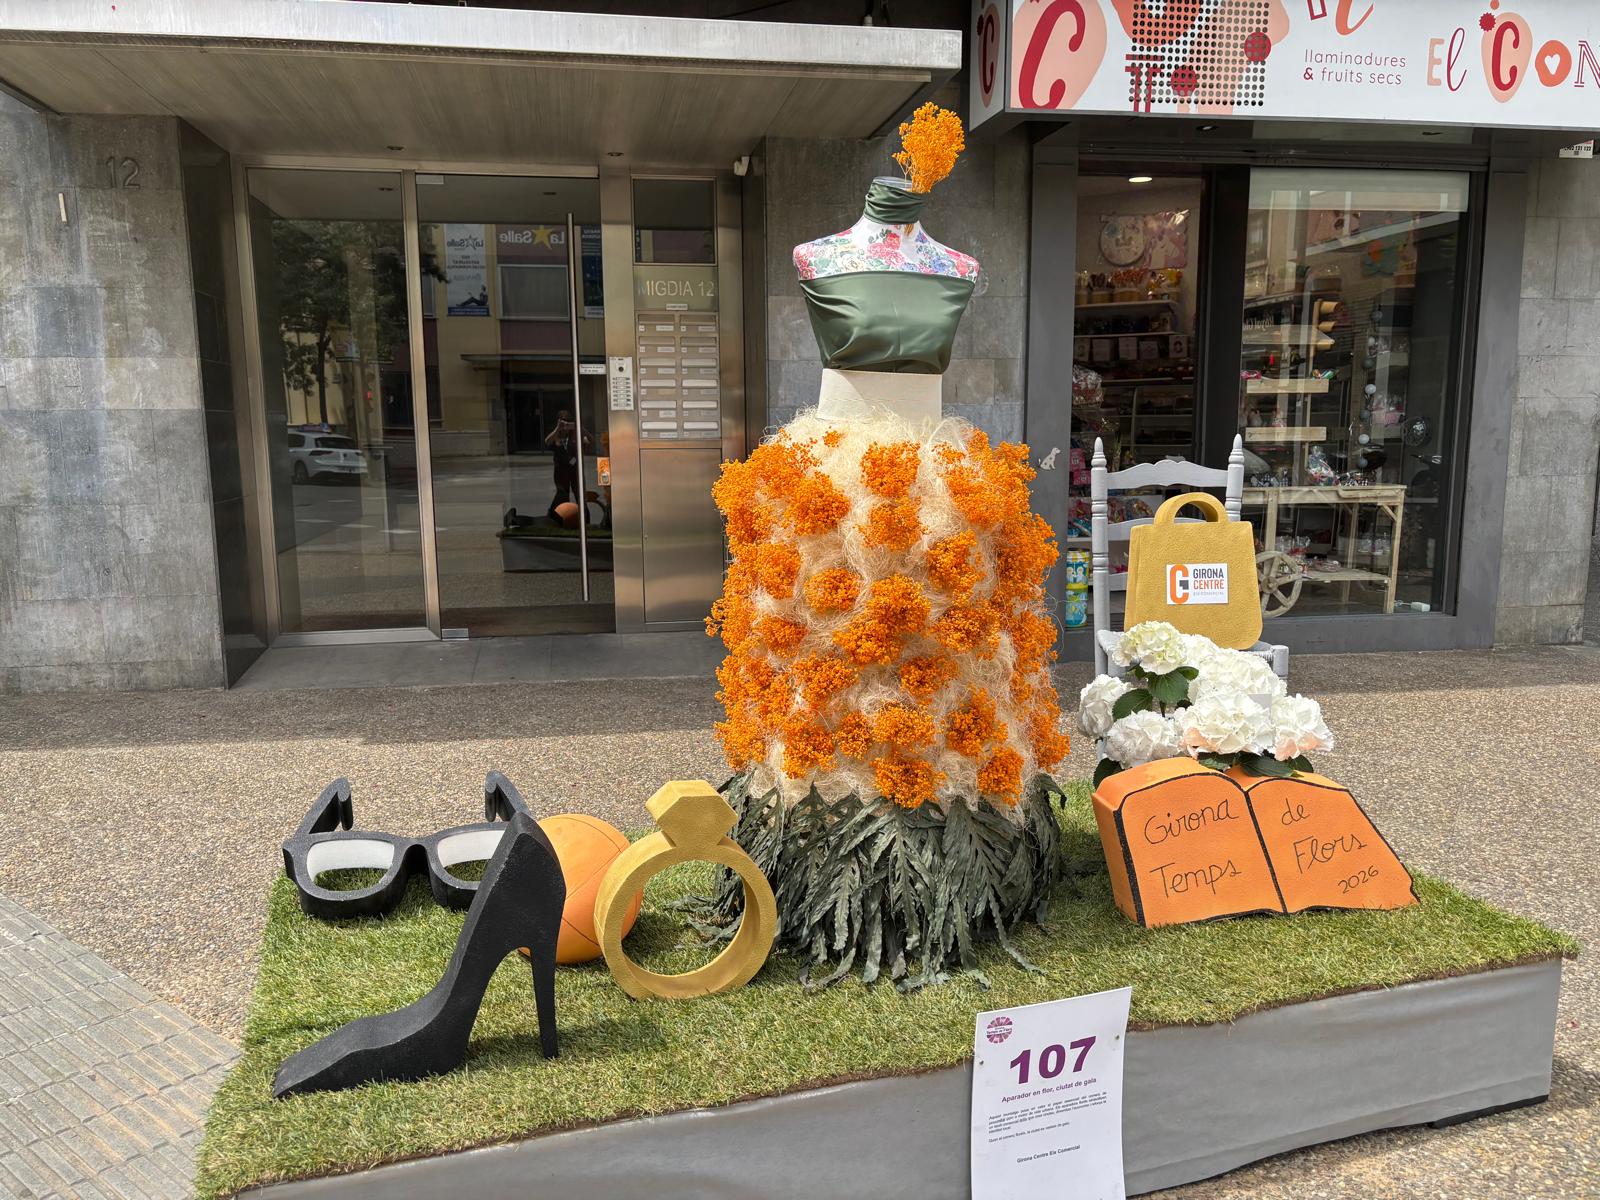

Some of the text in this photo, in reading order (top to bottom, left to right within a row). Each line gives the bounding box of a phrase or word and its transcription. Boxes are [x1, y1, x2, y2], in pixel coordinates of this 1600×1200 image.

[1304, 49, 1406, 67] llaminadures
[1303, 67, 1402, 85] & fruits secs
[106, 156, 141, 189] 12
[638, 280, 715, 297] MIGDIA 12
[1193, 568, 1224, 579] GIRONA
[1193, 579, 1224, 590] CENTRE
[1144, 799, 1239, 845] Girona
[1281, 798, 1310, 826] de
[1293, 833, 1367, 874] Flors
[1149, 859, 1242, 898] Temps
[1338, 865, 1379, 895] 2026
[1010, 1036, 1096, 1085] 107
[1001, 1091, 1032, 1103] Aparador
[1042, 1087, 1055, 1095] flor,
[1056, 1083, 1073, 1092] ciutat
[1075, 1080, 1083, 1088] de
[1083, 1077, 1097, 1088] gala
[1033, 1152, 1049, 1160] Centre
[1057, 1145, 1080, 1155] Comercial
